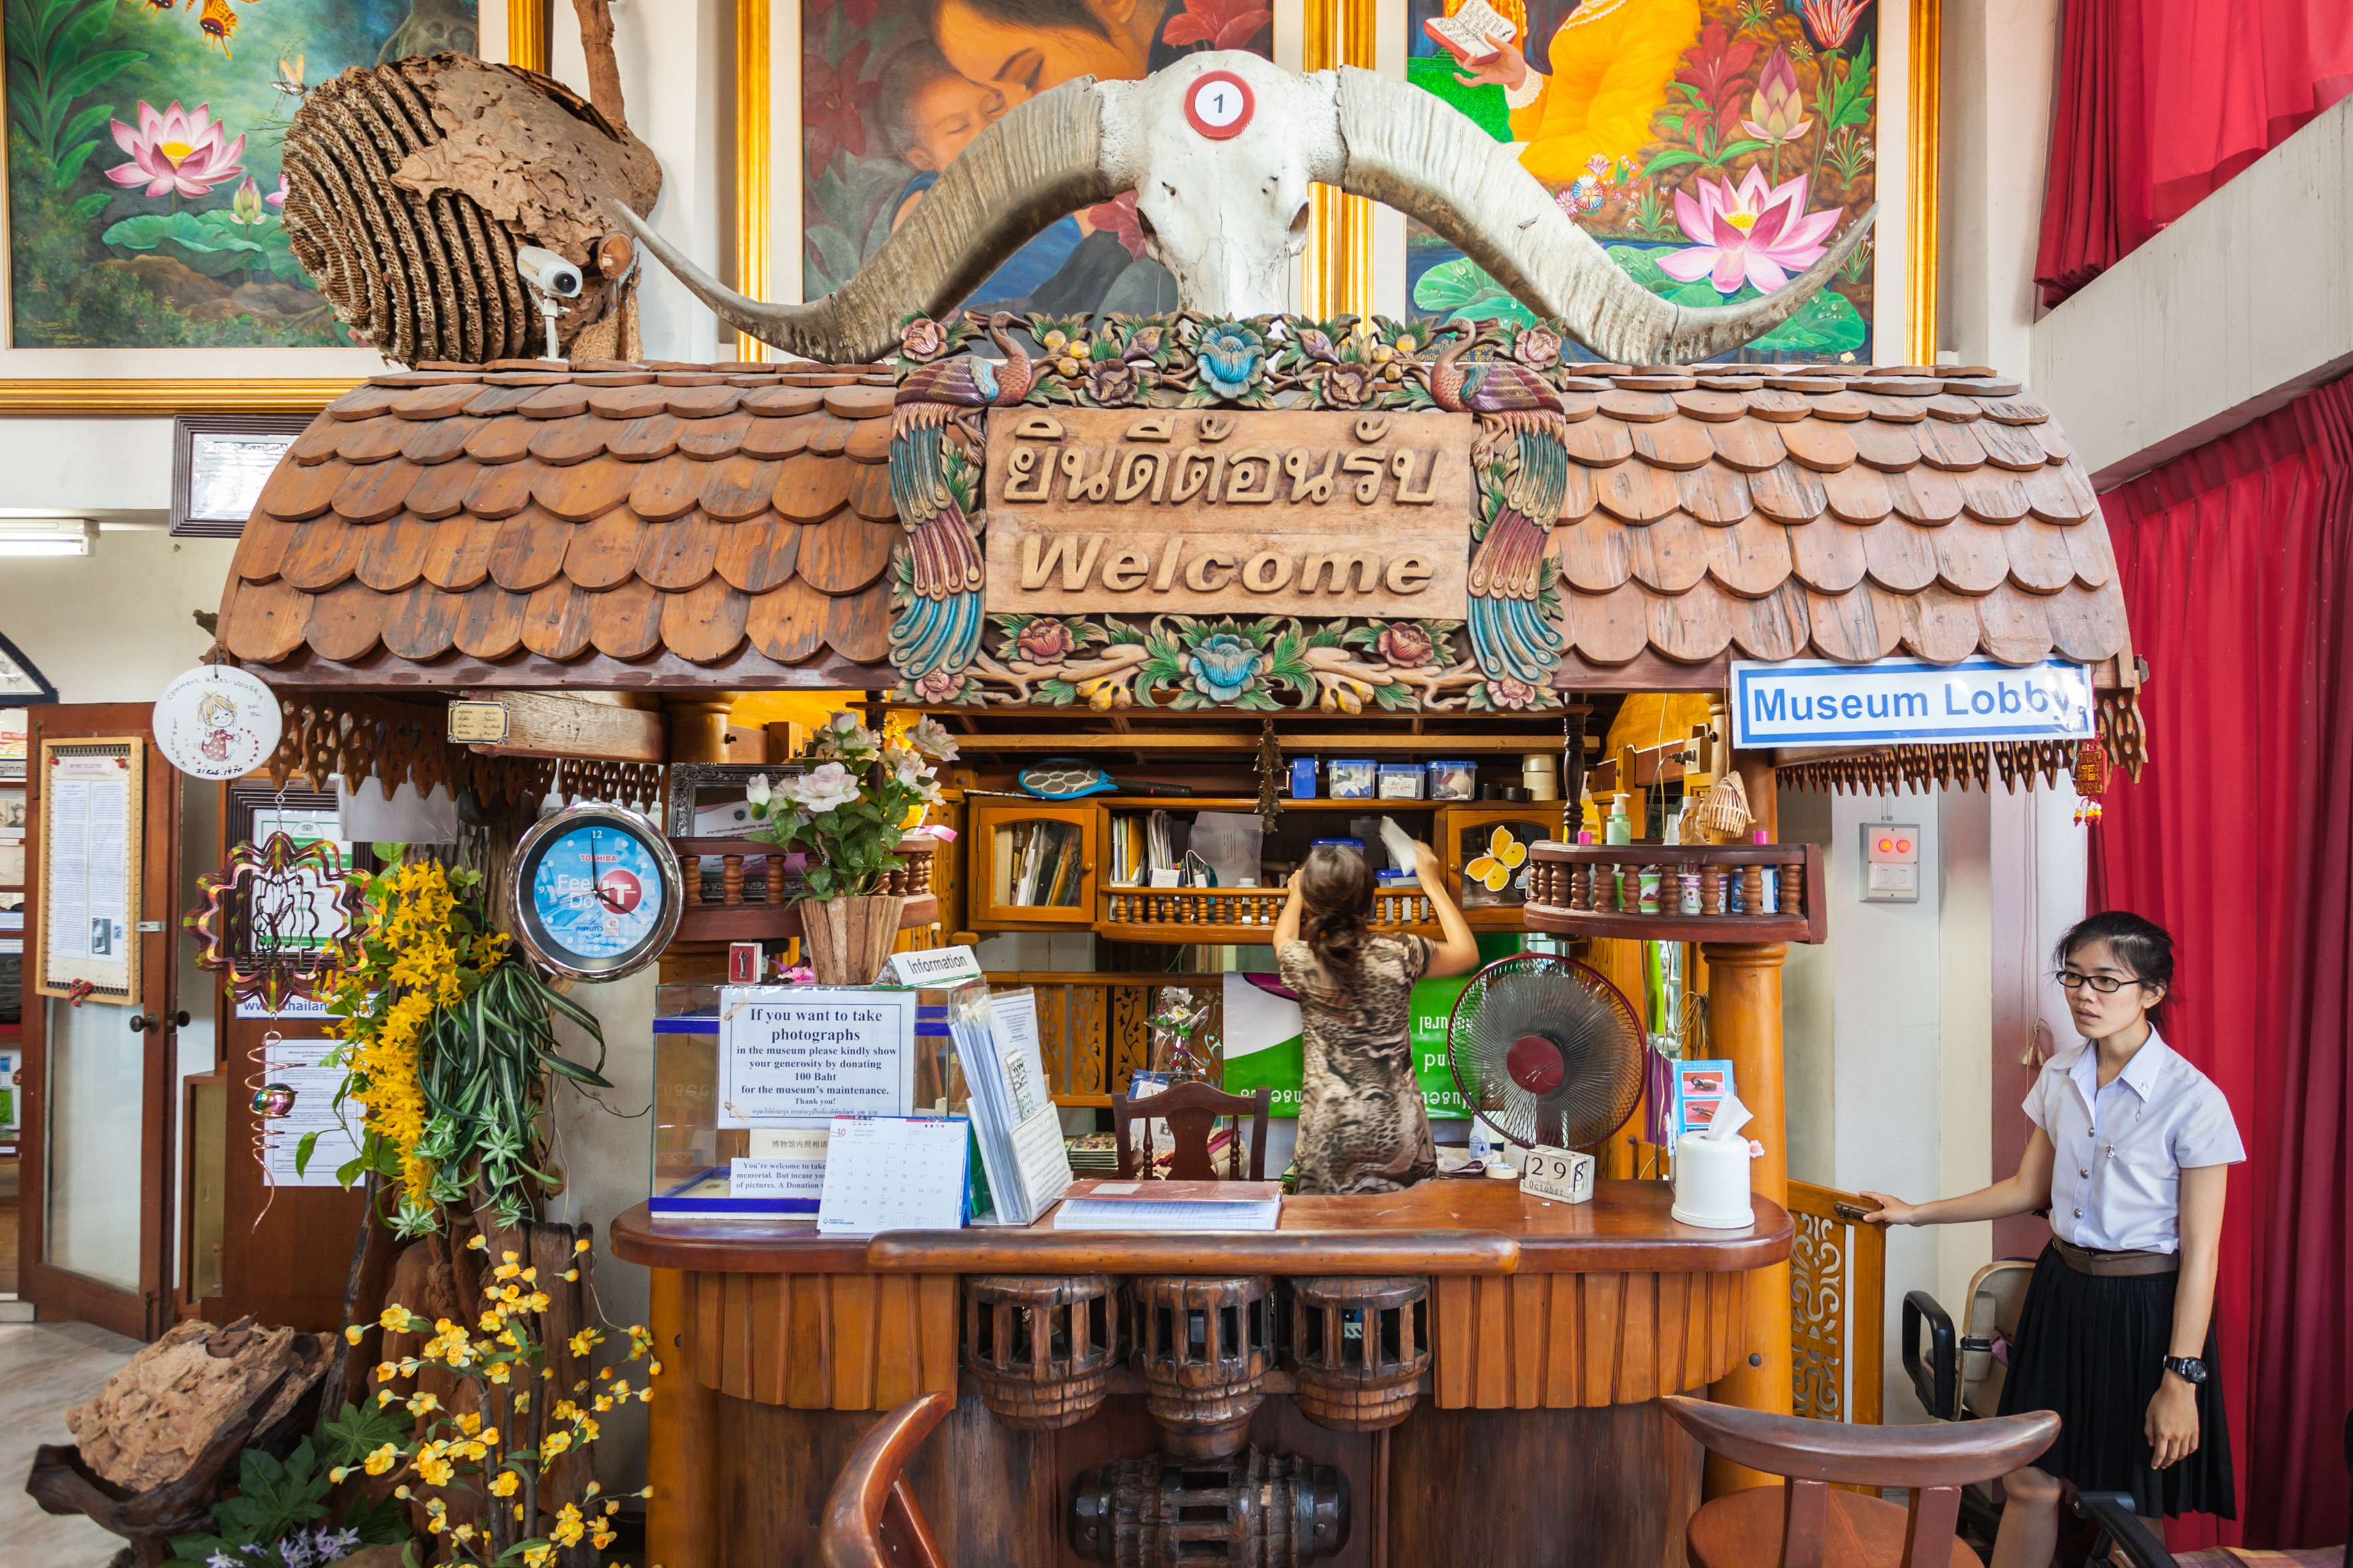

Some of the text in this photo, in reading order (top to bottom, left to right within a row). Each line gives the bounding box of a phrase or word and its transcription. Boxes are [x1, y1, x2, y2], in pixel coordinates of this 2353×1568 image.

[1214, 93, 1224, 113] 1
[1003, 414, 1445, 506] ยินดีต้อนรับ
[1020, 535, 1434, 596] Welcome
[1754, 680, 2073, 722] Museum Lobby
[224, 768, 243, 776] 1970
[592, 830, 603, 839] 12
[907, 954, 967, 974] Information
[750, 1008, 883, 1023] If you want to take
[771, 1028, 861, 1043] photographs
[737, 1046, 746, 1054] in
[749, 1046, 764, 1054] the
[809, 1046, 838, 1057] please
[841, 1046, 869, 1057] kindly
[873, 1046, 897, 1055] show
[749, 1059, 881, 1070] your generosity by donating
[795, 1072, 836, 1081] 100 Baht
[741, 1085, 755, 1094] for
[758, 1085, 773, 1094] the
[827, 1086, 889, 1094] maintenance.
[820, 1097, 835, 1106] you!
[745, 1182, 775, 1190] pictures.
[1529, 1181, 1564, 1196] October
